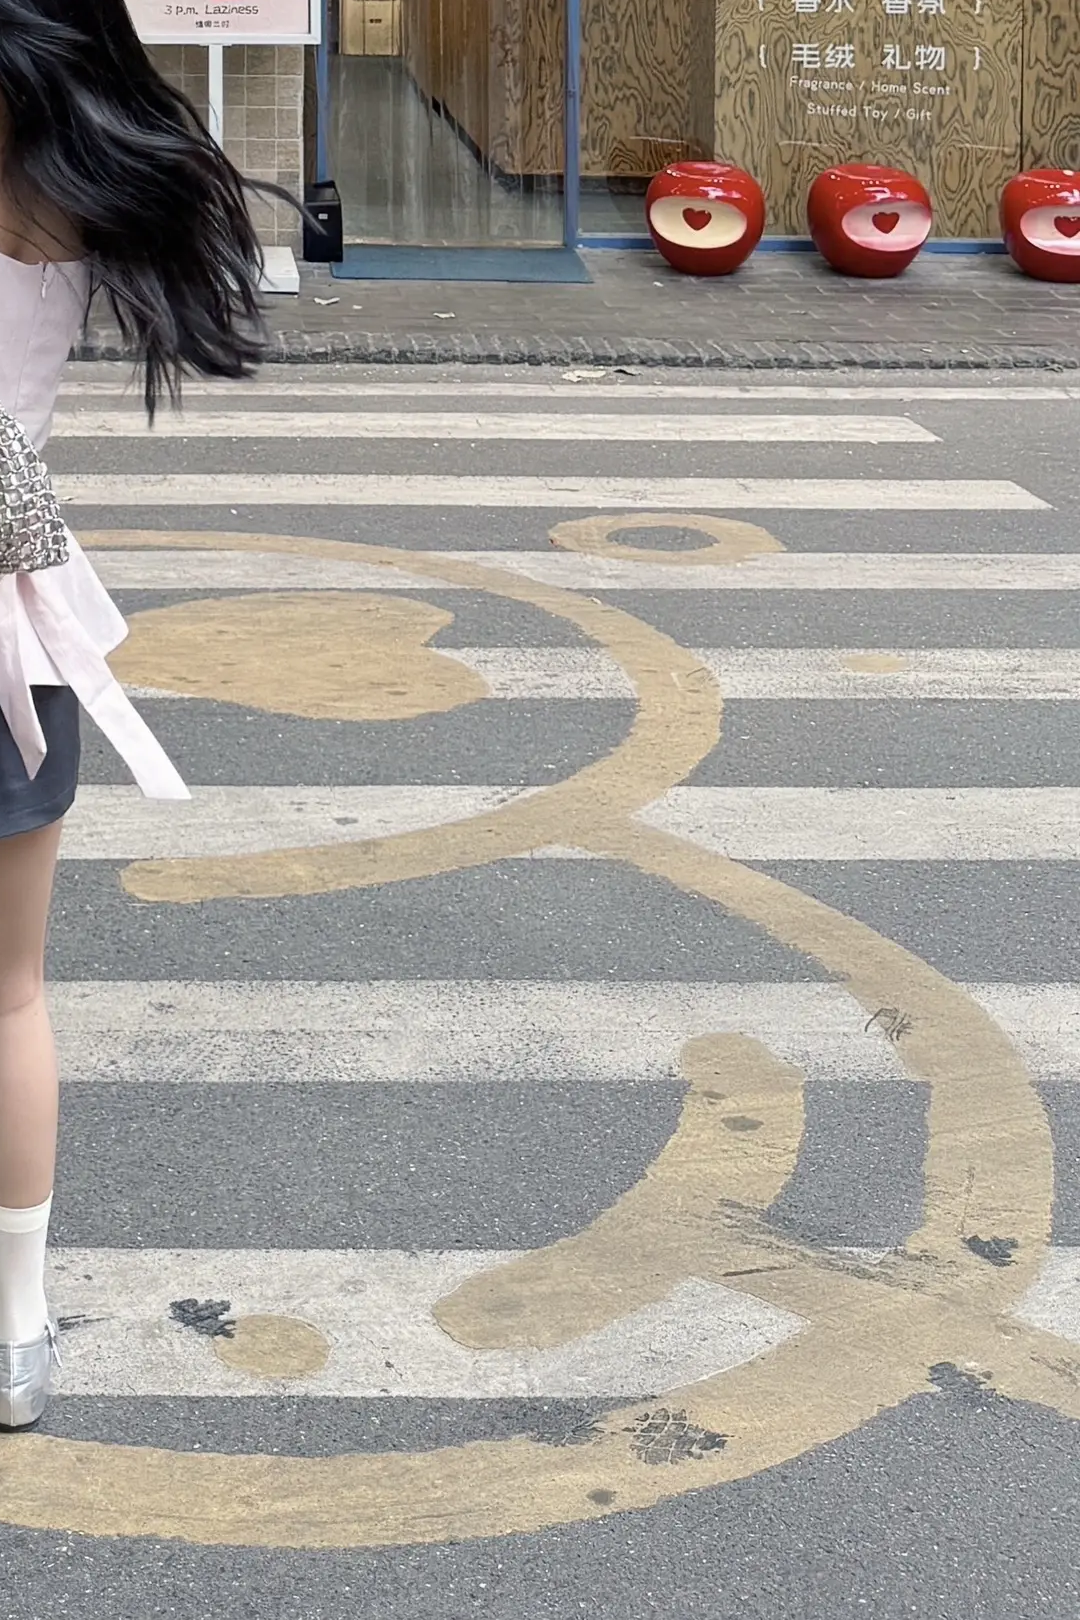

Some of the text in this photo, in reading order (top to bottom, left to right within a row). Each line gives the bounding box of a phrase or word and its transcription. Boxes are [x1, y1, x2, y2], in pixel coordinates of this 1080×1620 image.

[205, 4, 260, 15] Laziness
[792, 43, 856, 69] 毛绒
[882, 44, 946, 71] 礼物
[789, 76, 853, 94] Fragrance
[871, 82, 907, 94] Home
[912, 83, 951, 95] Scent
[806, 103, 857, 117] Stuffed
[863, 105, 889, 123] Toy
[906, 109, 932, 121] Gift
